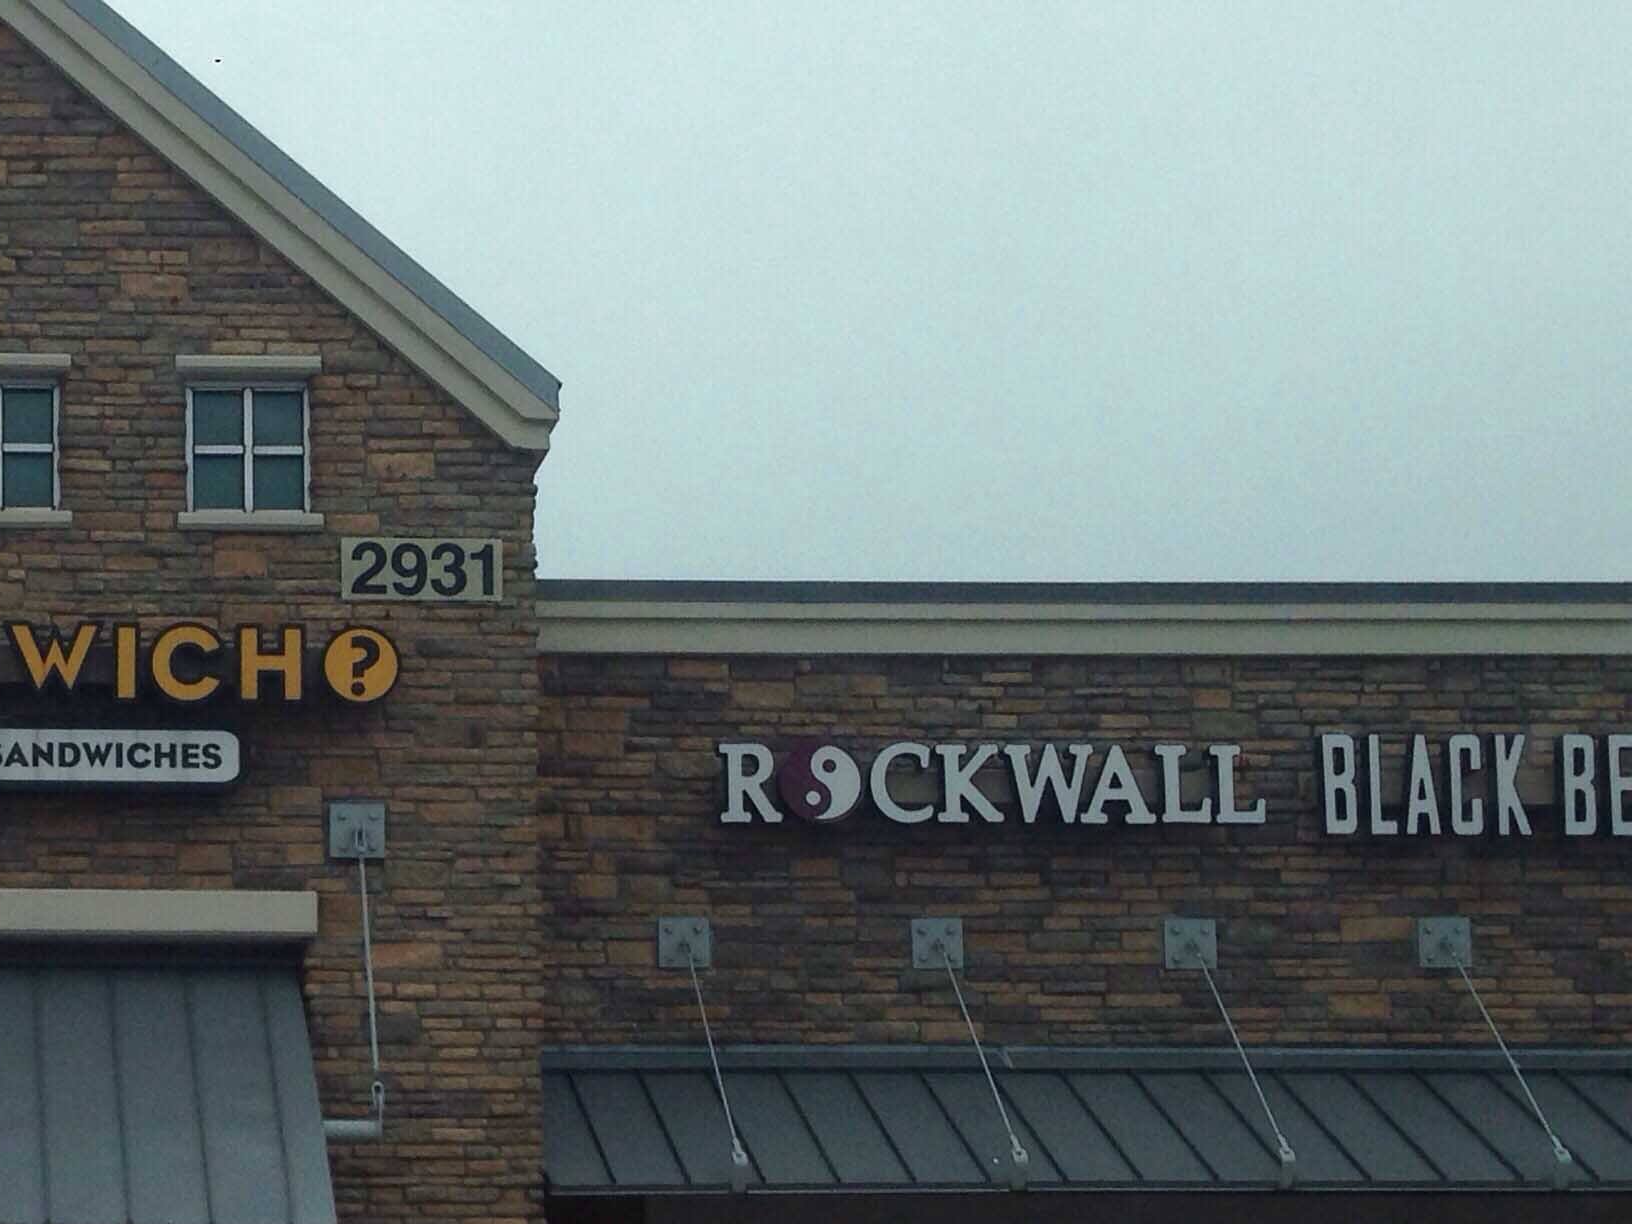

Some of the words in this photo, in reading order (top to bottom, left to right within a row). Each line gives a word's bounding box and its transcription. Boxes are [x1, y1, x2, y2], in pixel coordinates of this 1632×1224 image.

[351, 541, 495, 596] 2931
[718, 741, 1267, 824] ROCKWALL
[1321, 733, 1533, 836] BLACK
[1562, 733, 1632, 837] BE
